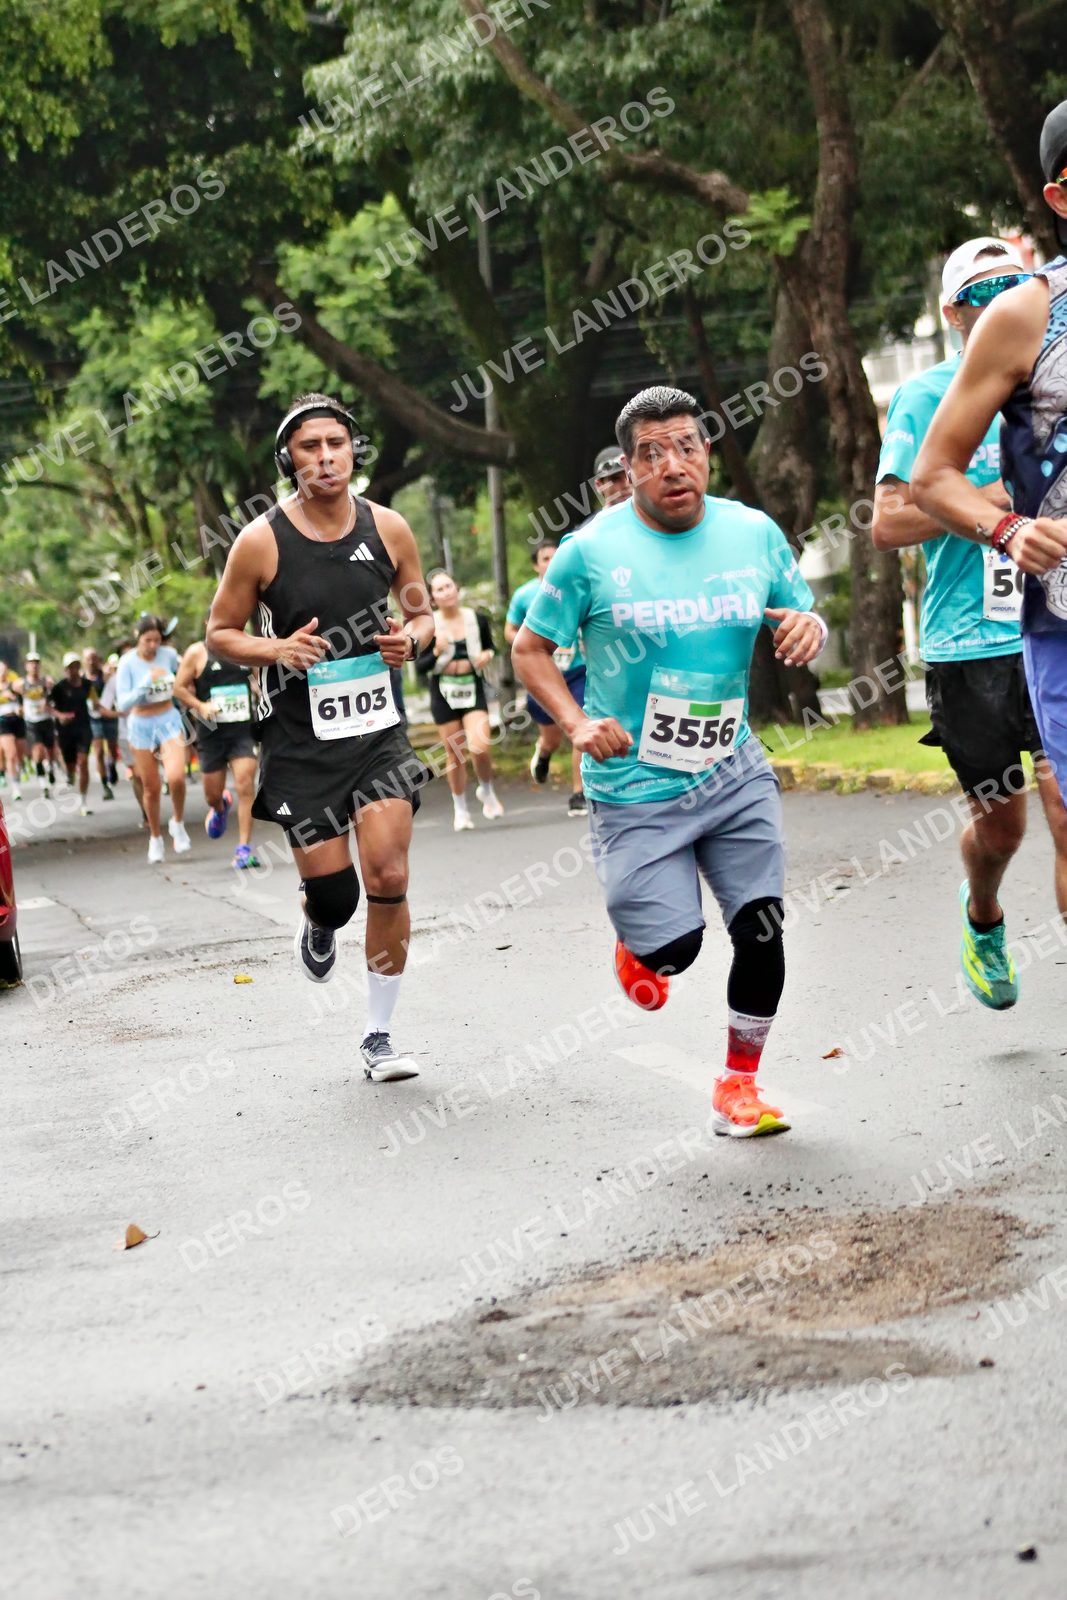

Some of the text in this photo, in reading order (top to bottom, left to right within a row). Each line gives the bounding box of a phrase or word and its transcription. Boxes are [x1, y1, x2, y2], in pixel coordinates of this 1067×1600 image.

[611, 592, 760, 628] PERDURA
[318, 686, 387, 721] 6103
[649, 713, 736, 749] 3556
[646, 749, 672, 760] PERDURA
